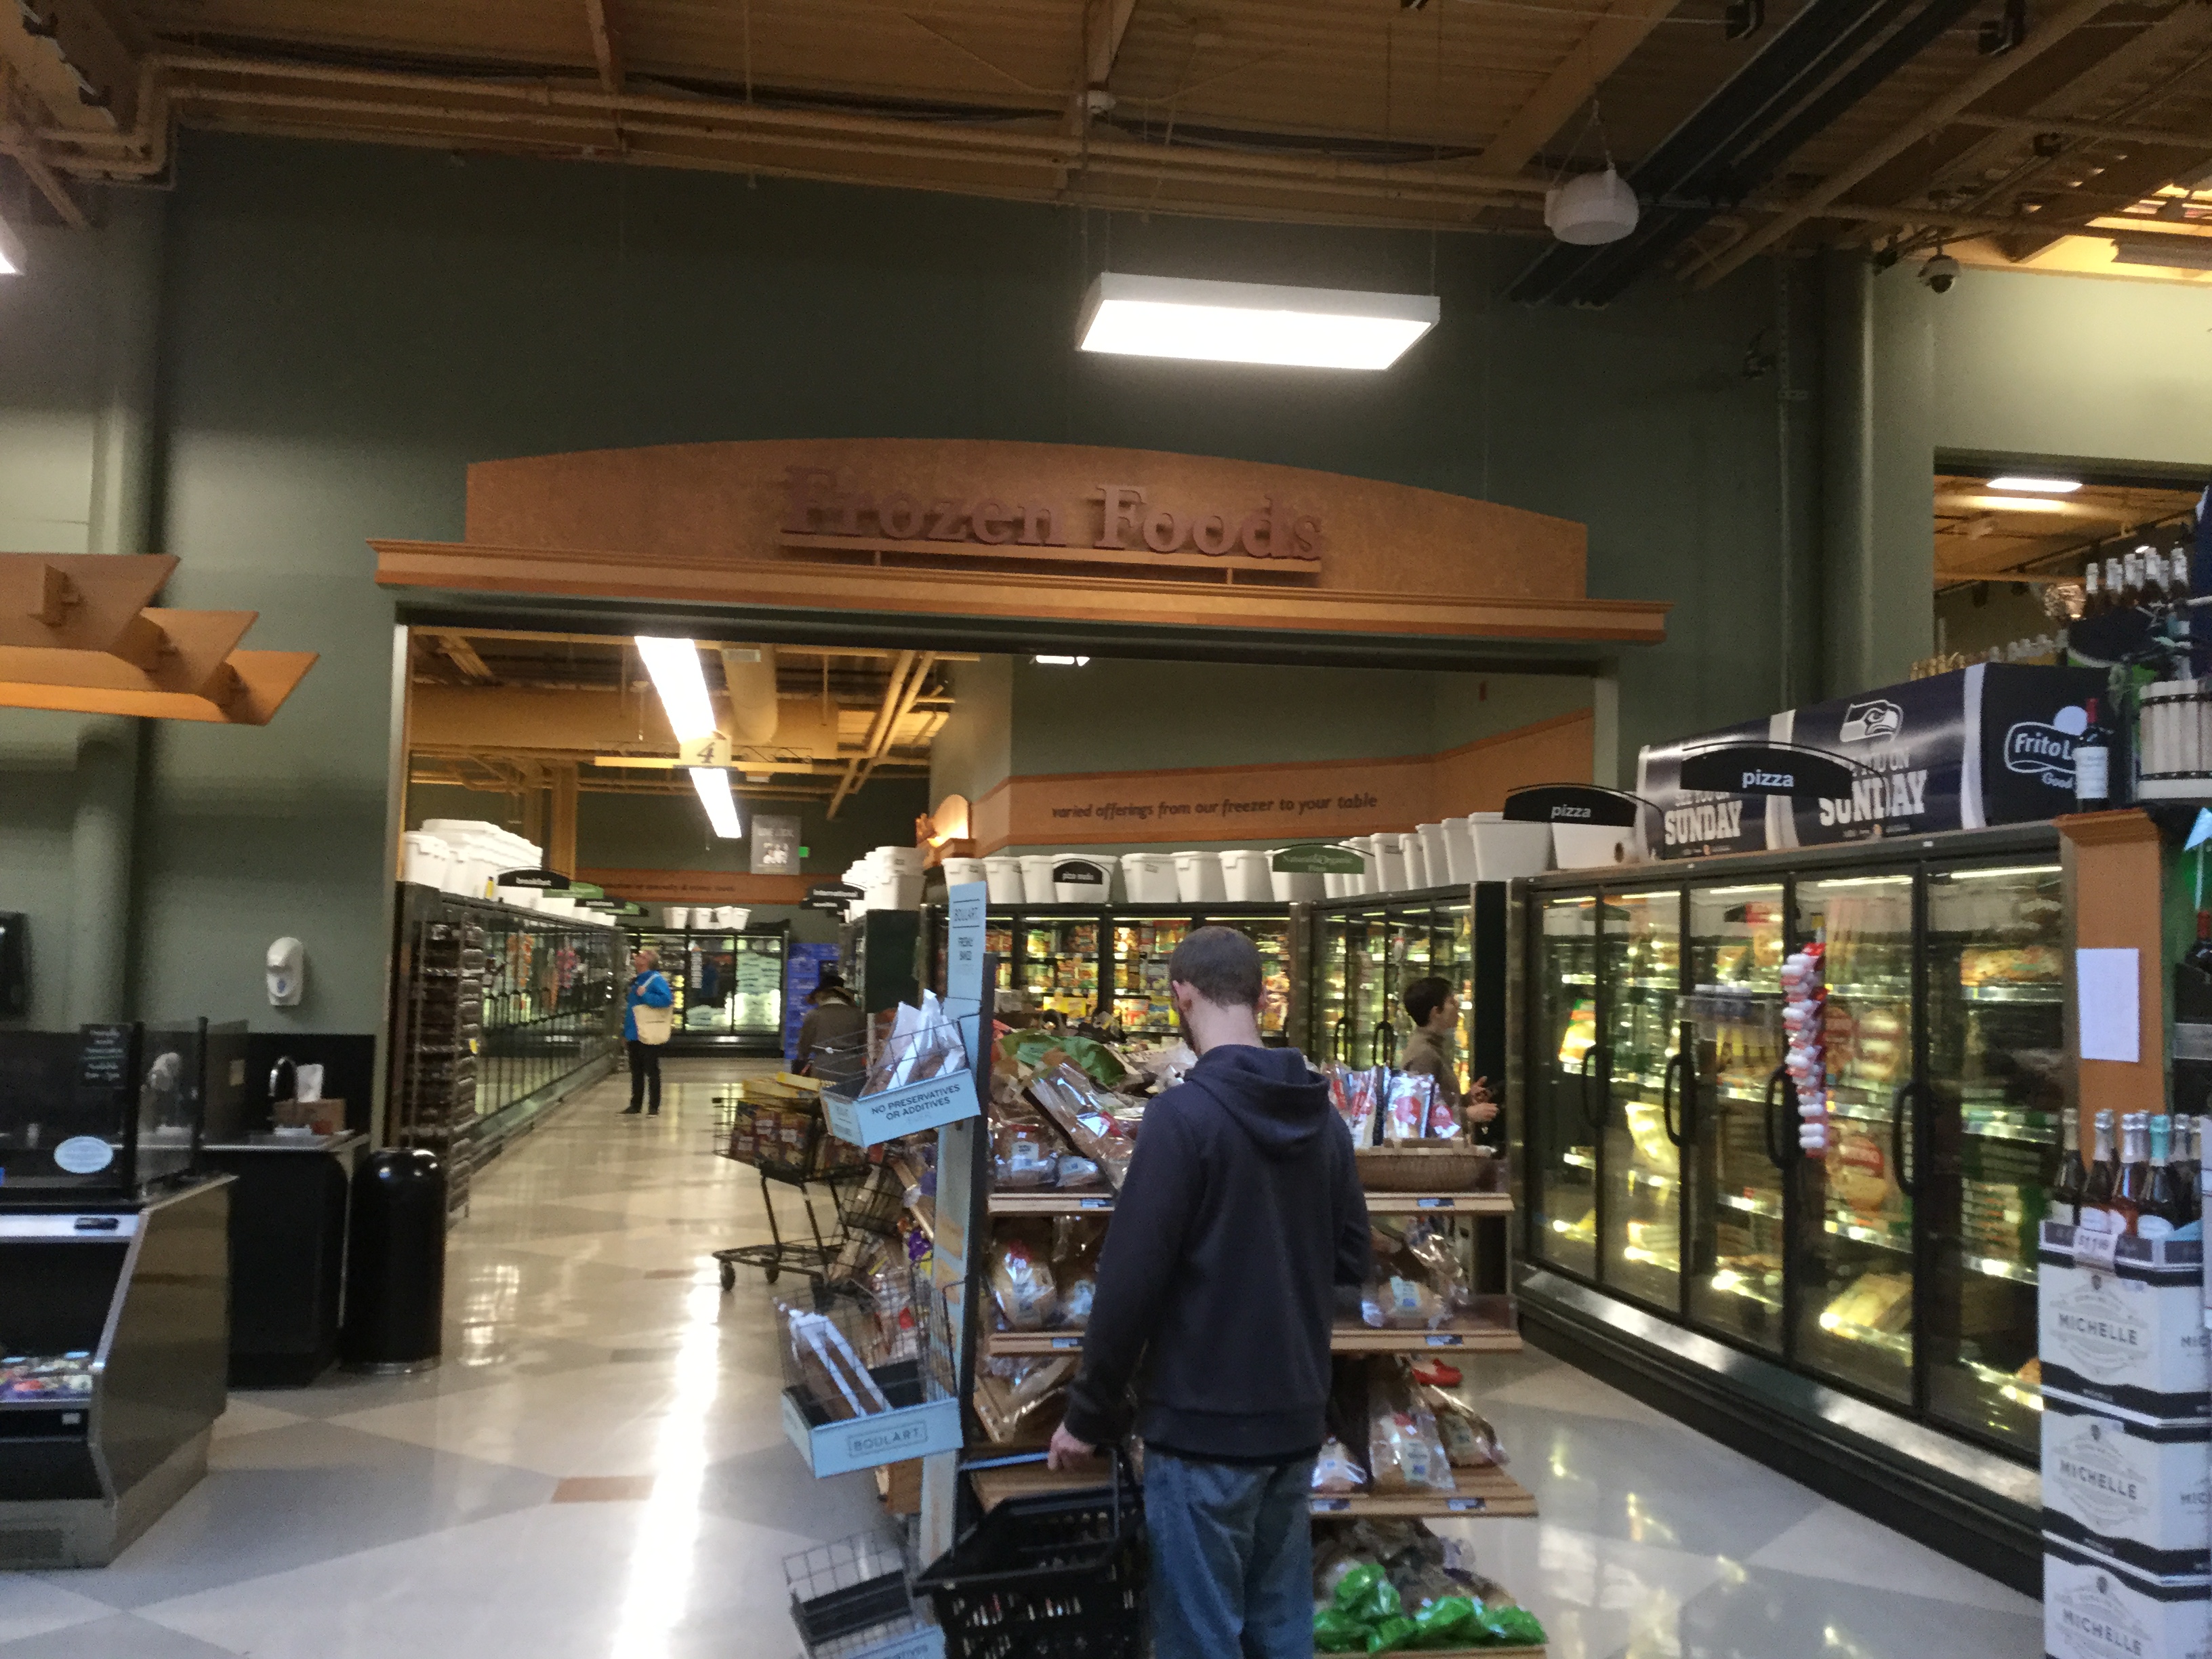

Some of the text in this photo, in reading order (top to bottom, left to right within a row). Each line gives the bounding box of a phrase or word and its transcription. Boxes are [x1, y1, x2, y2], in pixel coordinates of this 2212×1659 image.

[781, 466, 1322, 560] Frozen Foods
[696, 741, 716, 764] 4
[1742, 769, 1795, 789] pizza
[1052, 792, 1378, 820] varied offerings from our freezer to your table
[1550, 804, 1591, 819] pizza
[1818, 769, 1929, 826] SUNDAY
[1664, 800, 1743, 846] SUNDAY
[871, 1104, 886, 1115] NO
[887, 1084, 961, 1111] PRESERVATIVES
[885, 1109, 901, 1121] OR
[902, 1096, 951, 1117] ADDITIVES
[2058, 1312, 2138, 1346] MICHELLE
[853, 1427, 921, 1452] BOULART
[2060, 1458, 2137, 1500] MICHELLE
[2062, 1607, 2142, 1658] MICHELLE
